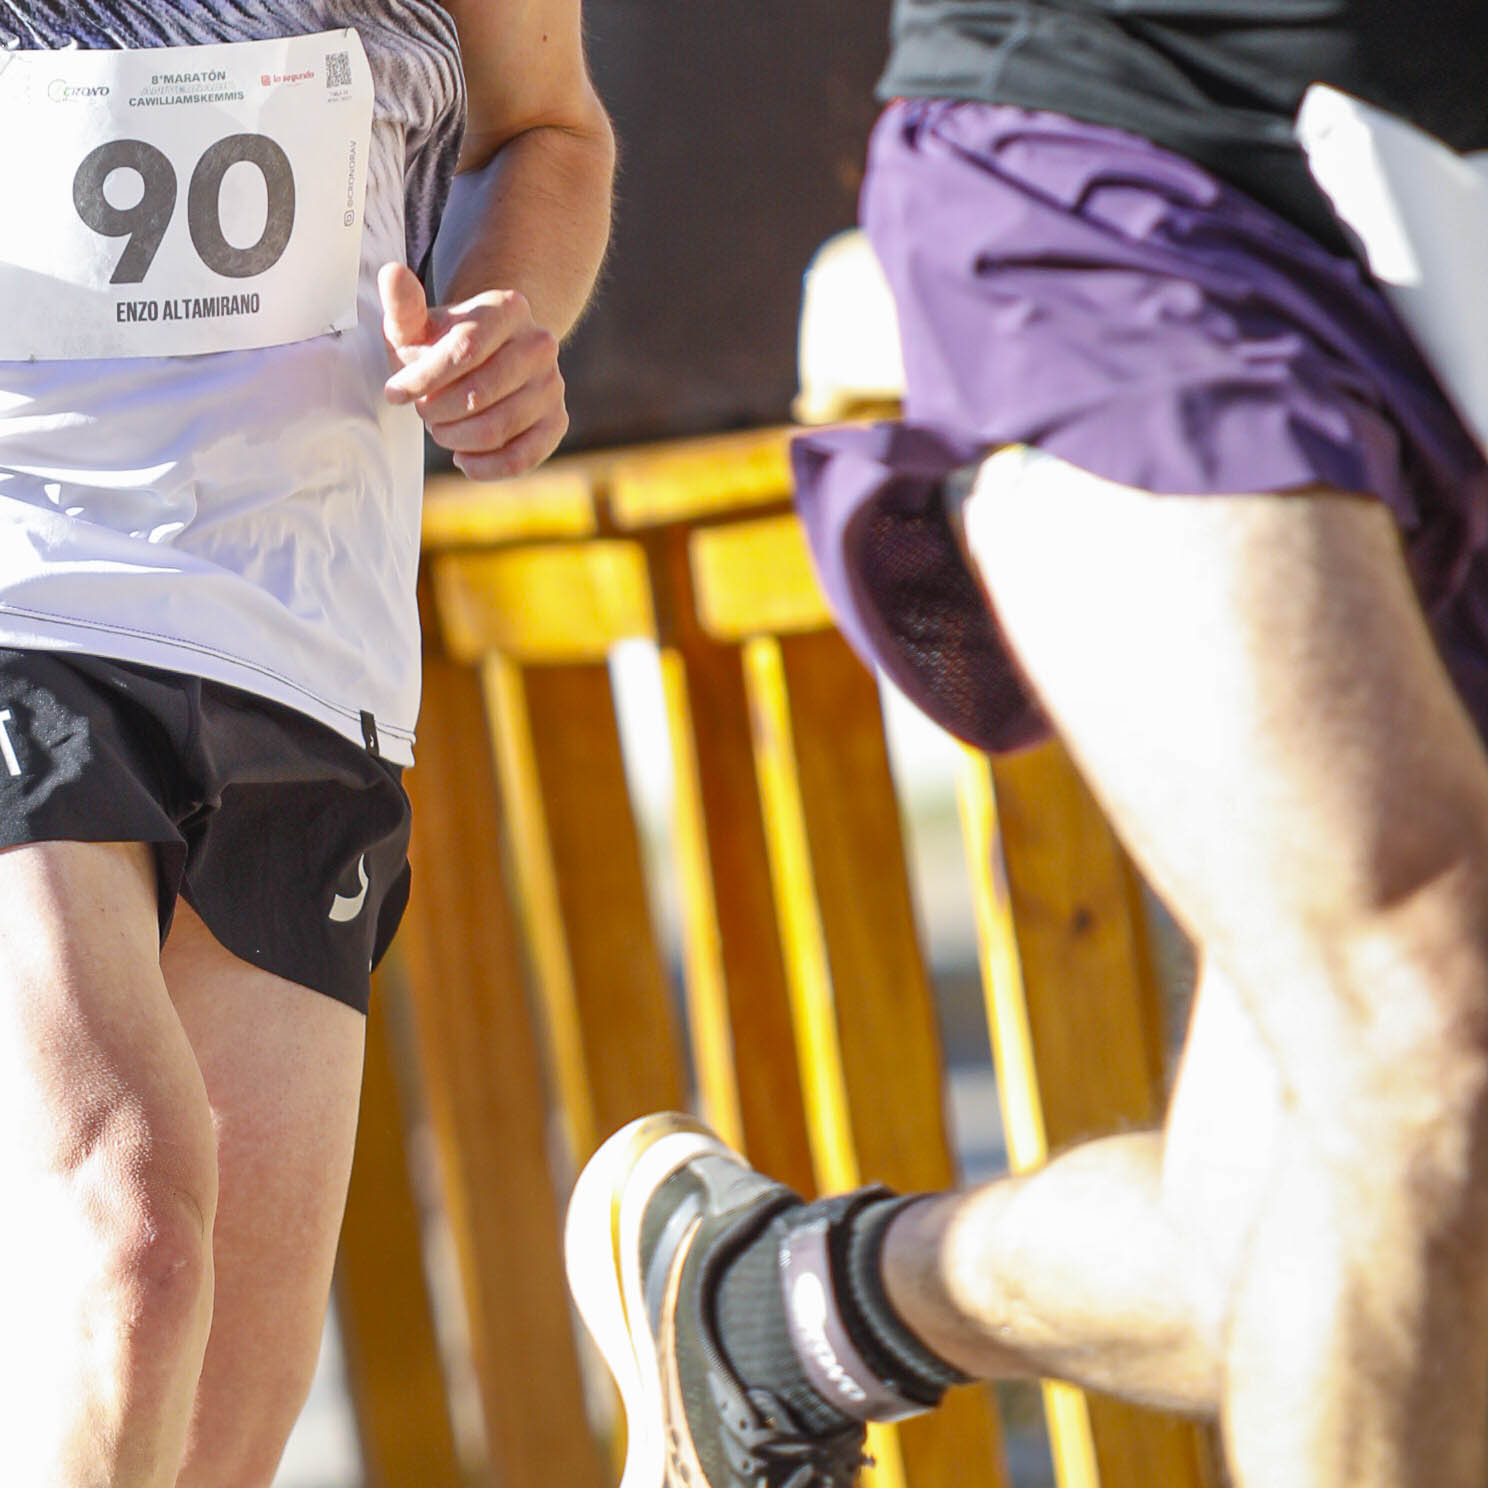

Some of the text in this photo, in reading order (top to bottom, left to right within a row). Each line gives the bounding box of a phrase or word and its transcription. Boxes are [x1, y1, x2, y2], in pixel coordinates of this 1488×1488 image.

[72, 133, 296, 285] 90
[116, 293, 261, 323] ENZO ALTAMIRANO
